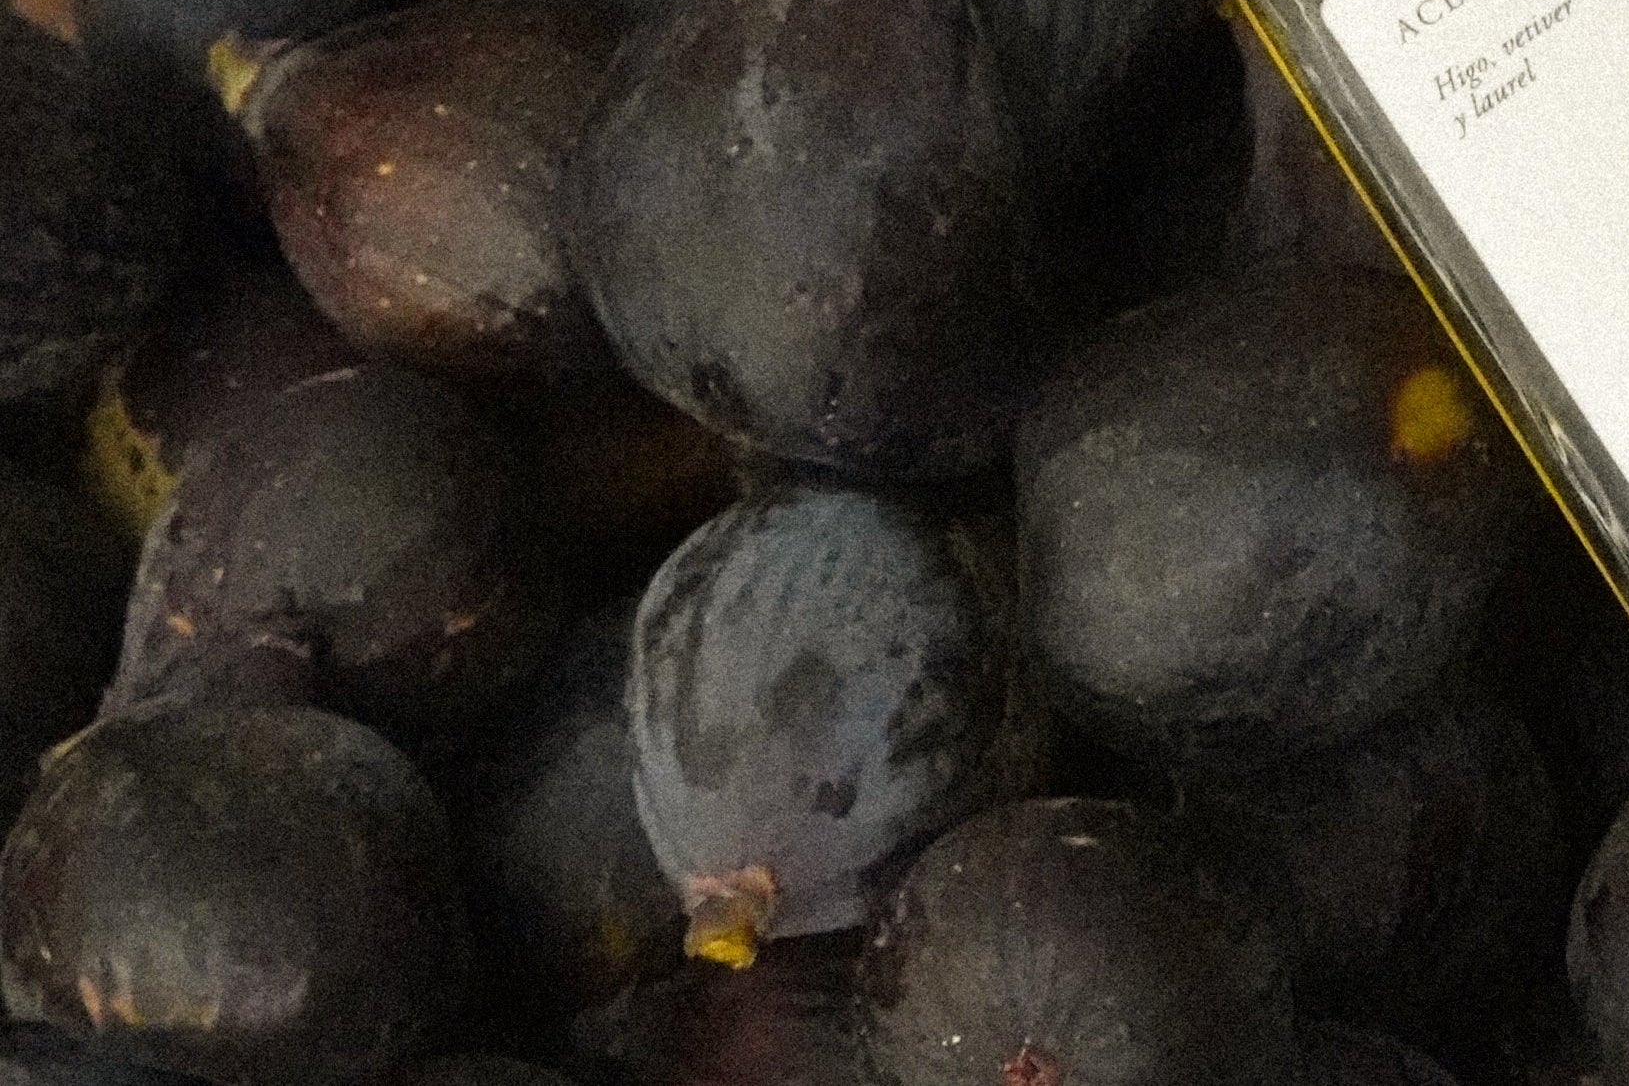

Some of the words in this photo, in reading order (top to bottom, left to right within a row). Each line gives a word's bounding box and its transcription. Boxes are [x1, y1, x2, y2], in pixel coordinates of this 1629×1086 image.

[1434, 59, 1497, 101] Higo,
[1454, 113, 1468, 139] y
[1472, 59, 1536, 118] laurel
